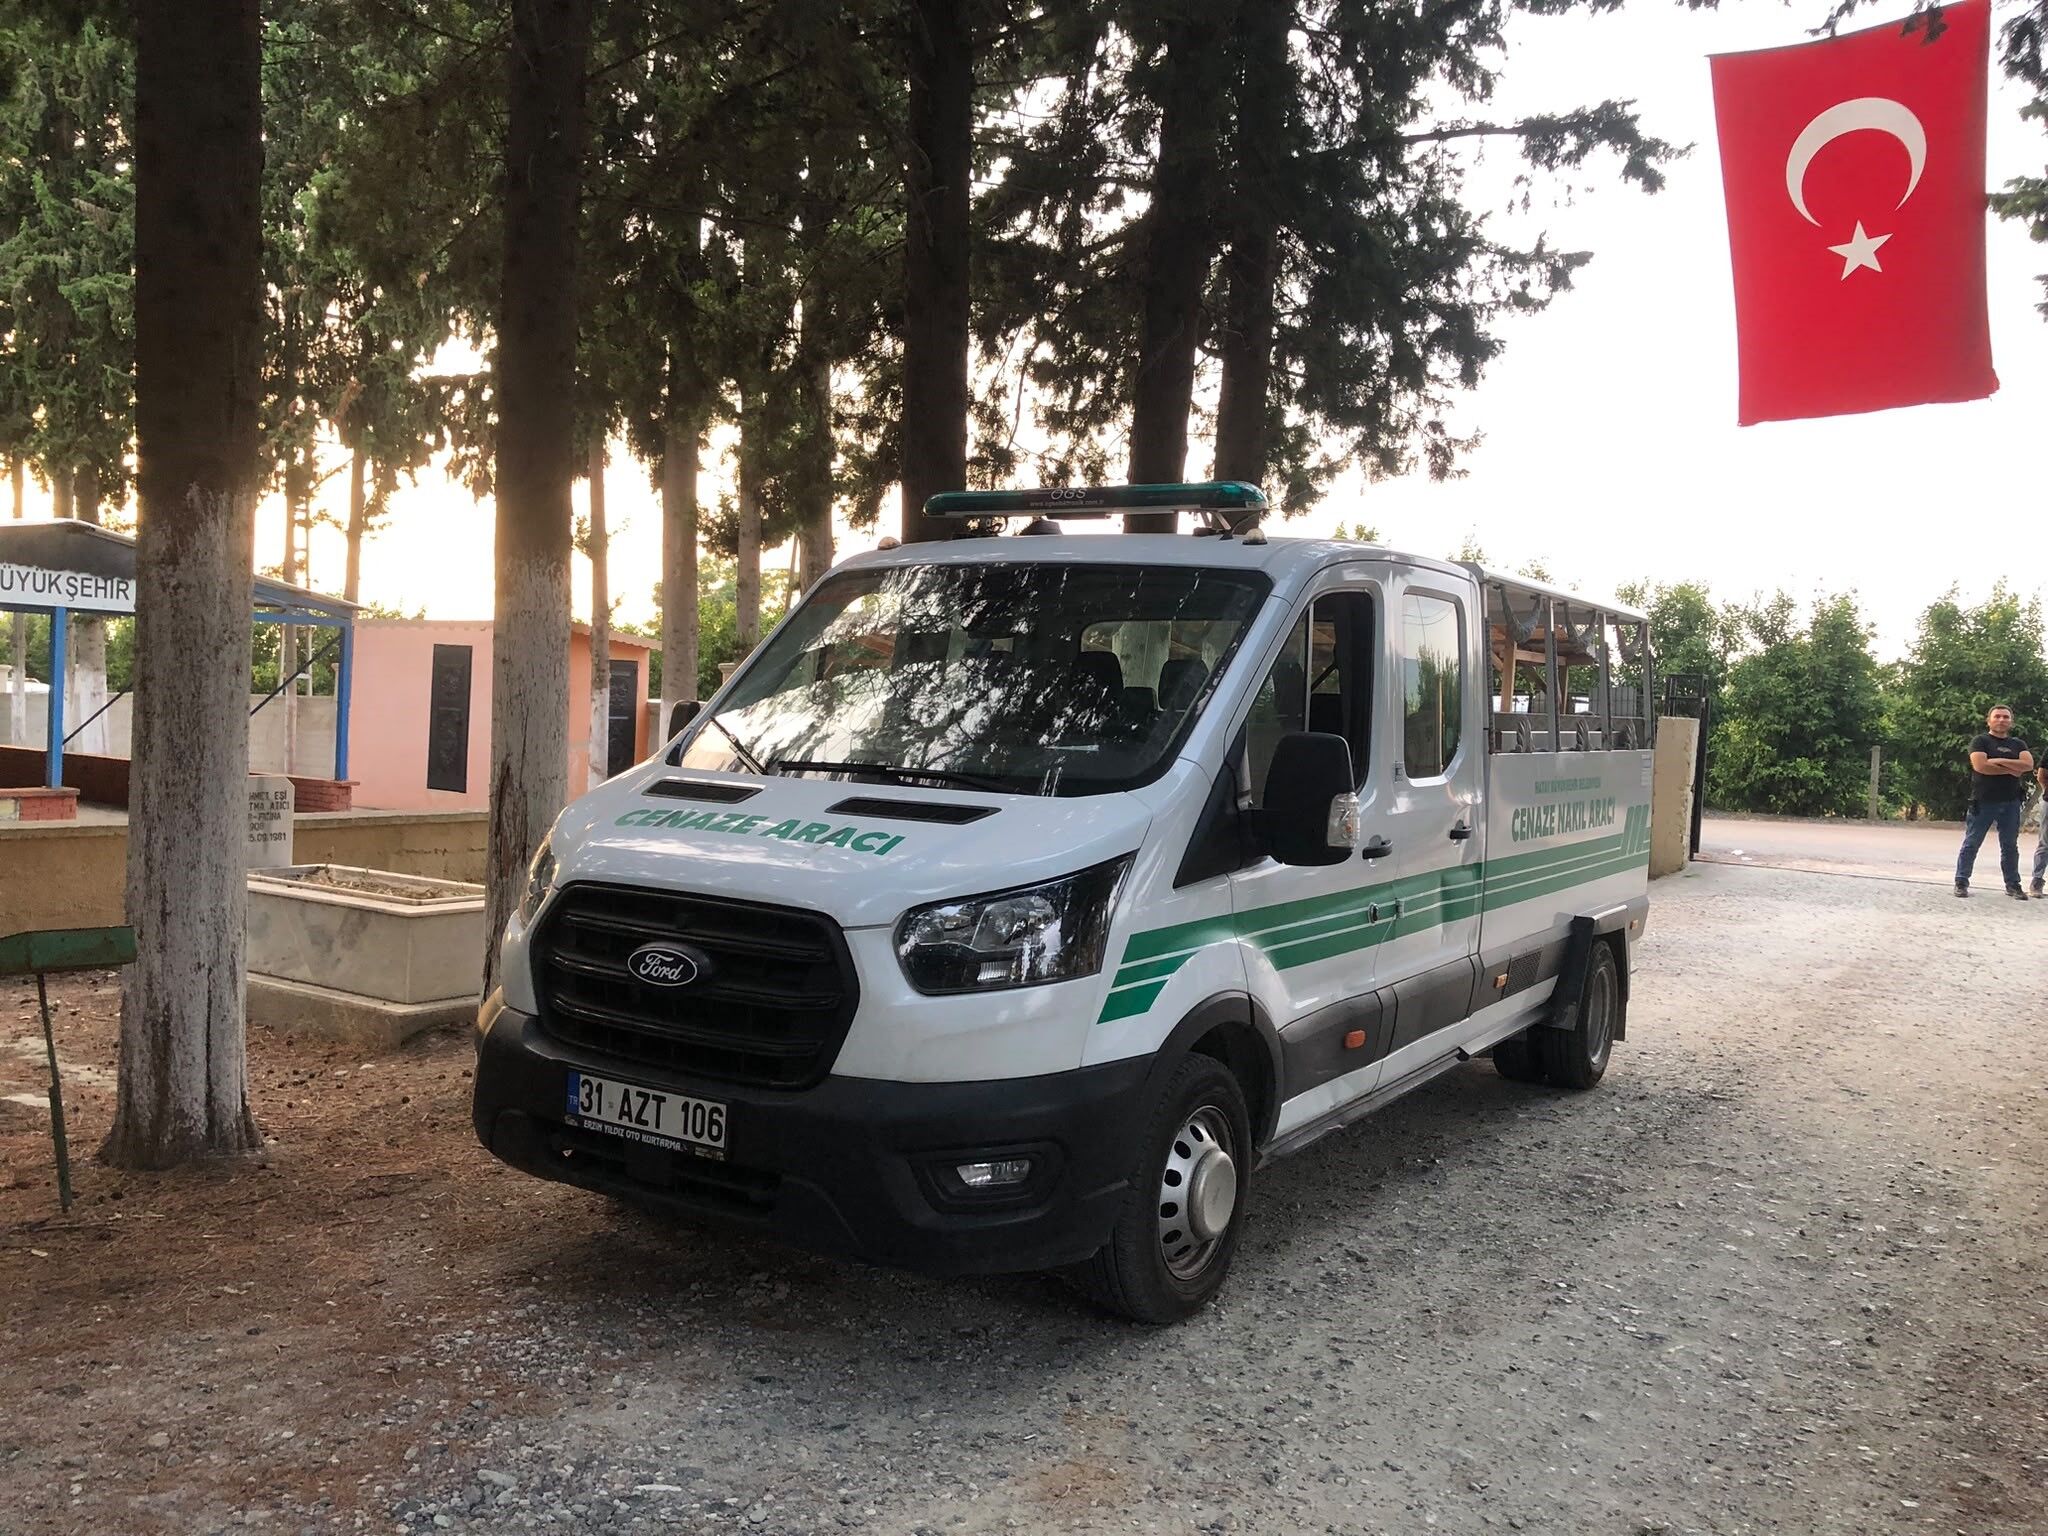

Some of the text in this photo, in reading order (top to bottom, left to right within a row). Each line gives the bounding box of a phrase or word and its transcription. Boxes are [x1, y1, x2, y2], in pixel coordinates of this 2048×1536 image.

[613, 808, 906, 856] CENAZE ARACI
[1512, 804, 1555, 842] CENAZE
[1588, 797, 1616, 828] ARACI
[638, 952, 685, 981] Ford
[568, 1078, 724, 1143] TR 31 AZT 106
[625, 1129, 640, 1141] OTO
